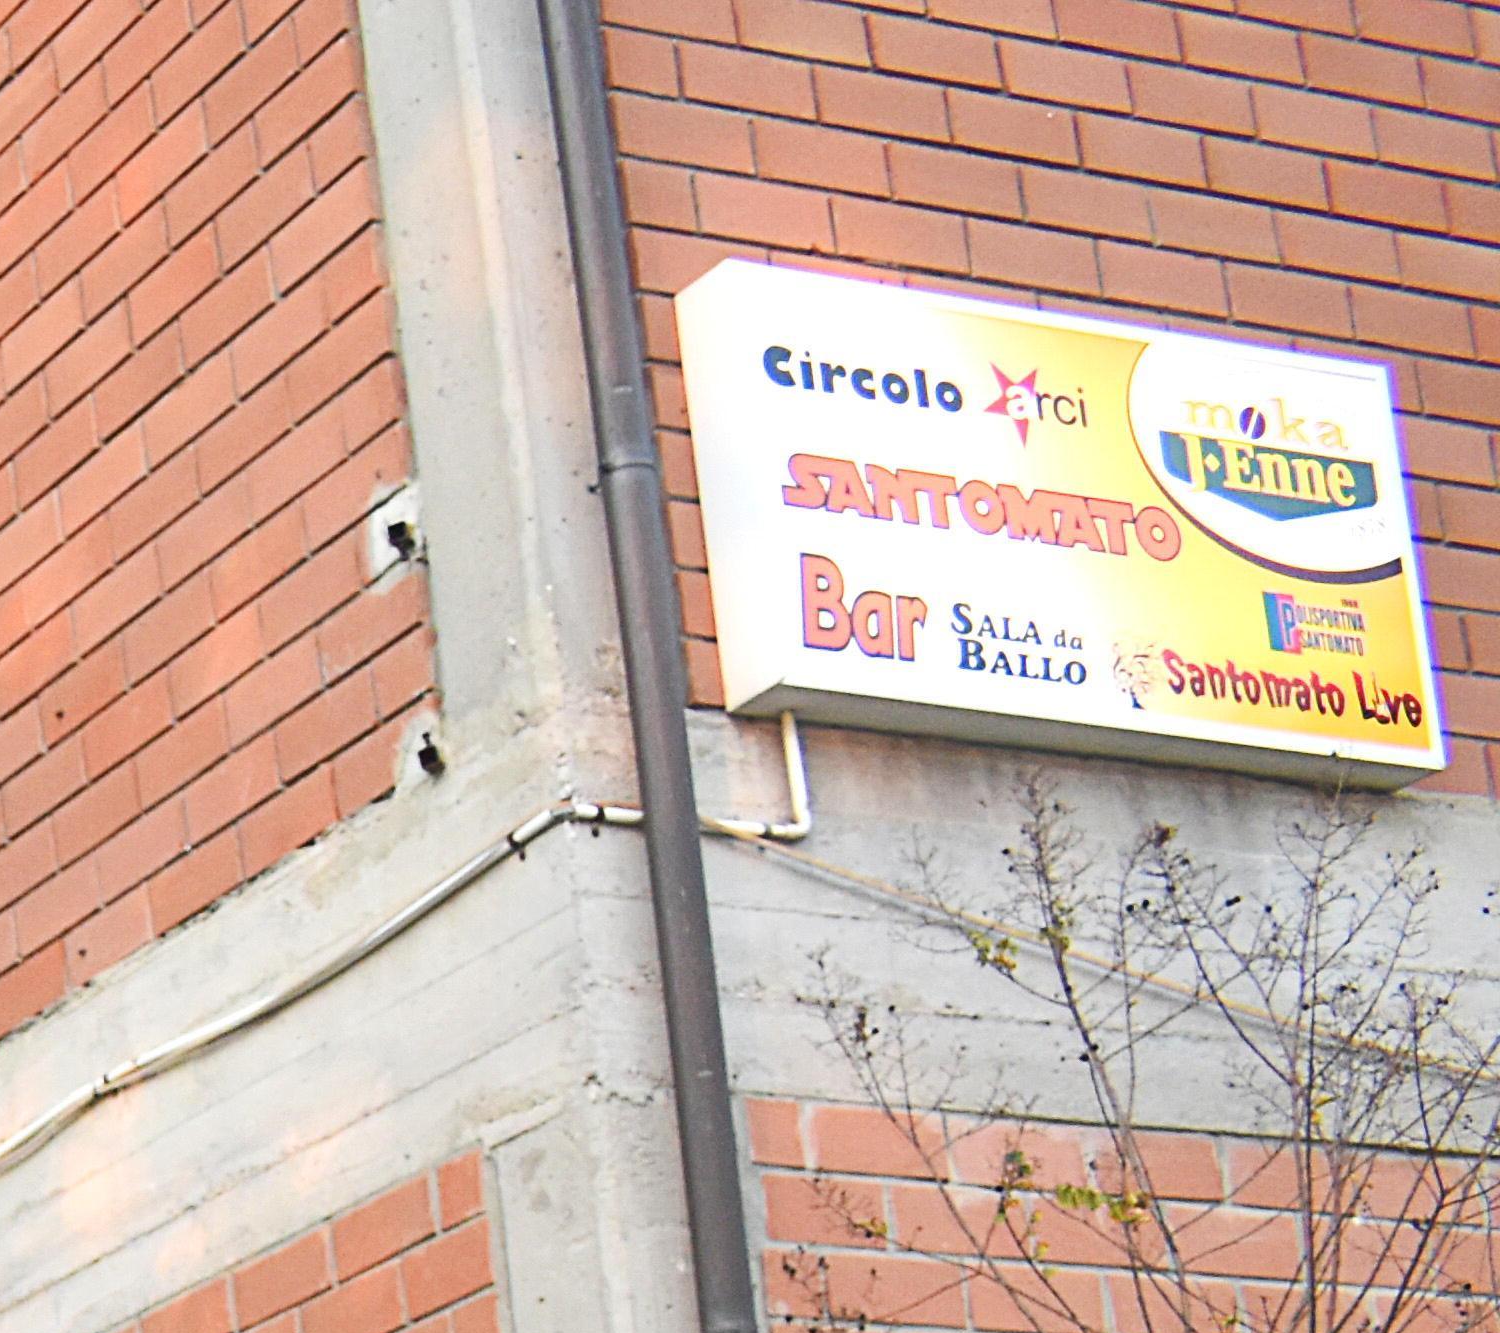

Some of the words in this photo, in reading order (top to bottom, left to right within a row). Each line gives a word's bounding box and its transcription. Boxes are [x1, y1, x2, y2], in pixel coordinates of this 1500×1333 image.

[762, 345, 965, 413] Circolo
[782, 452, 1184, 562] SANTOMATO
[800, 552, 928, 662] Bar
[950, 603, 1040, 646] SALA
[1053, 628, 1085, 653] da
[957, 637, 1089, 687] BALLO
[1167, 649, 1347, 718] Santomato
